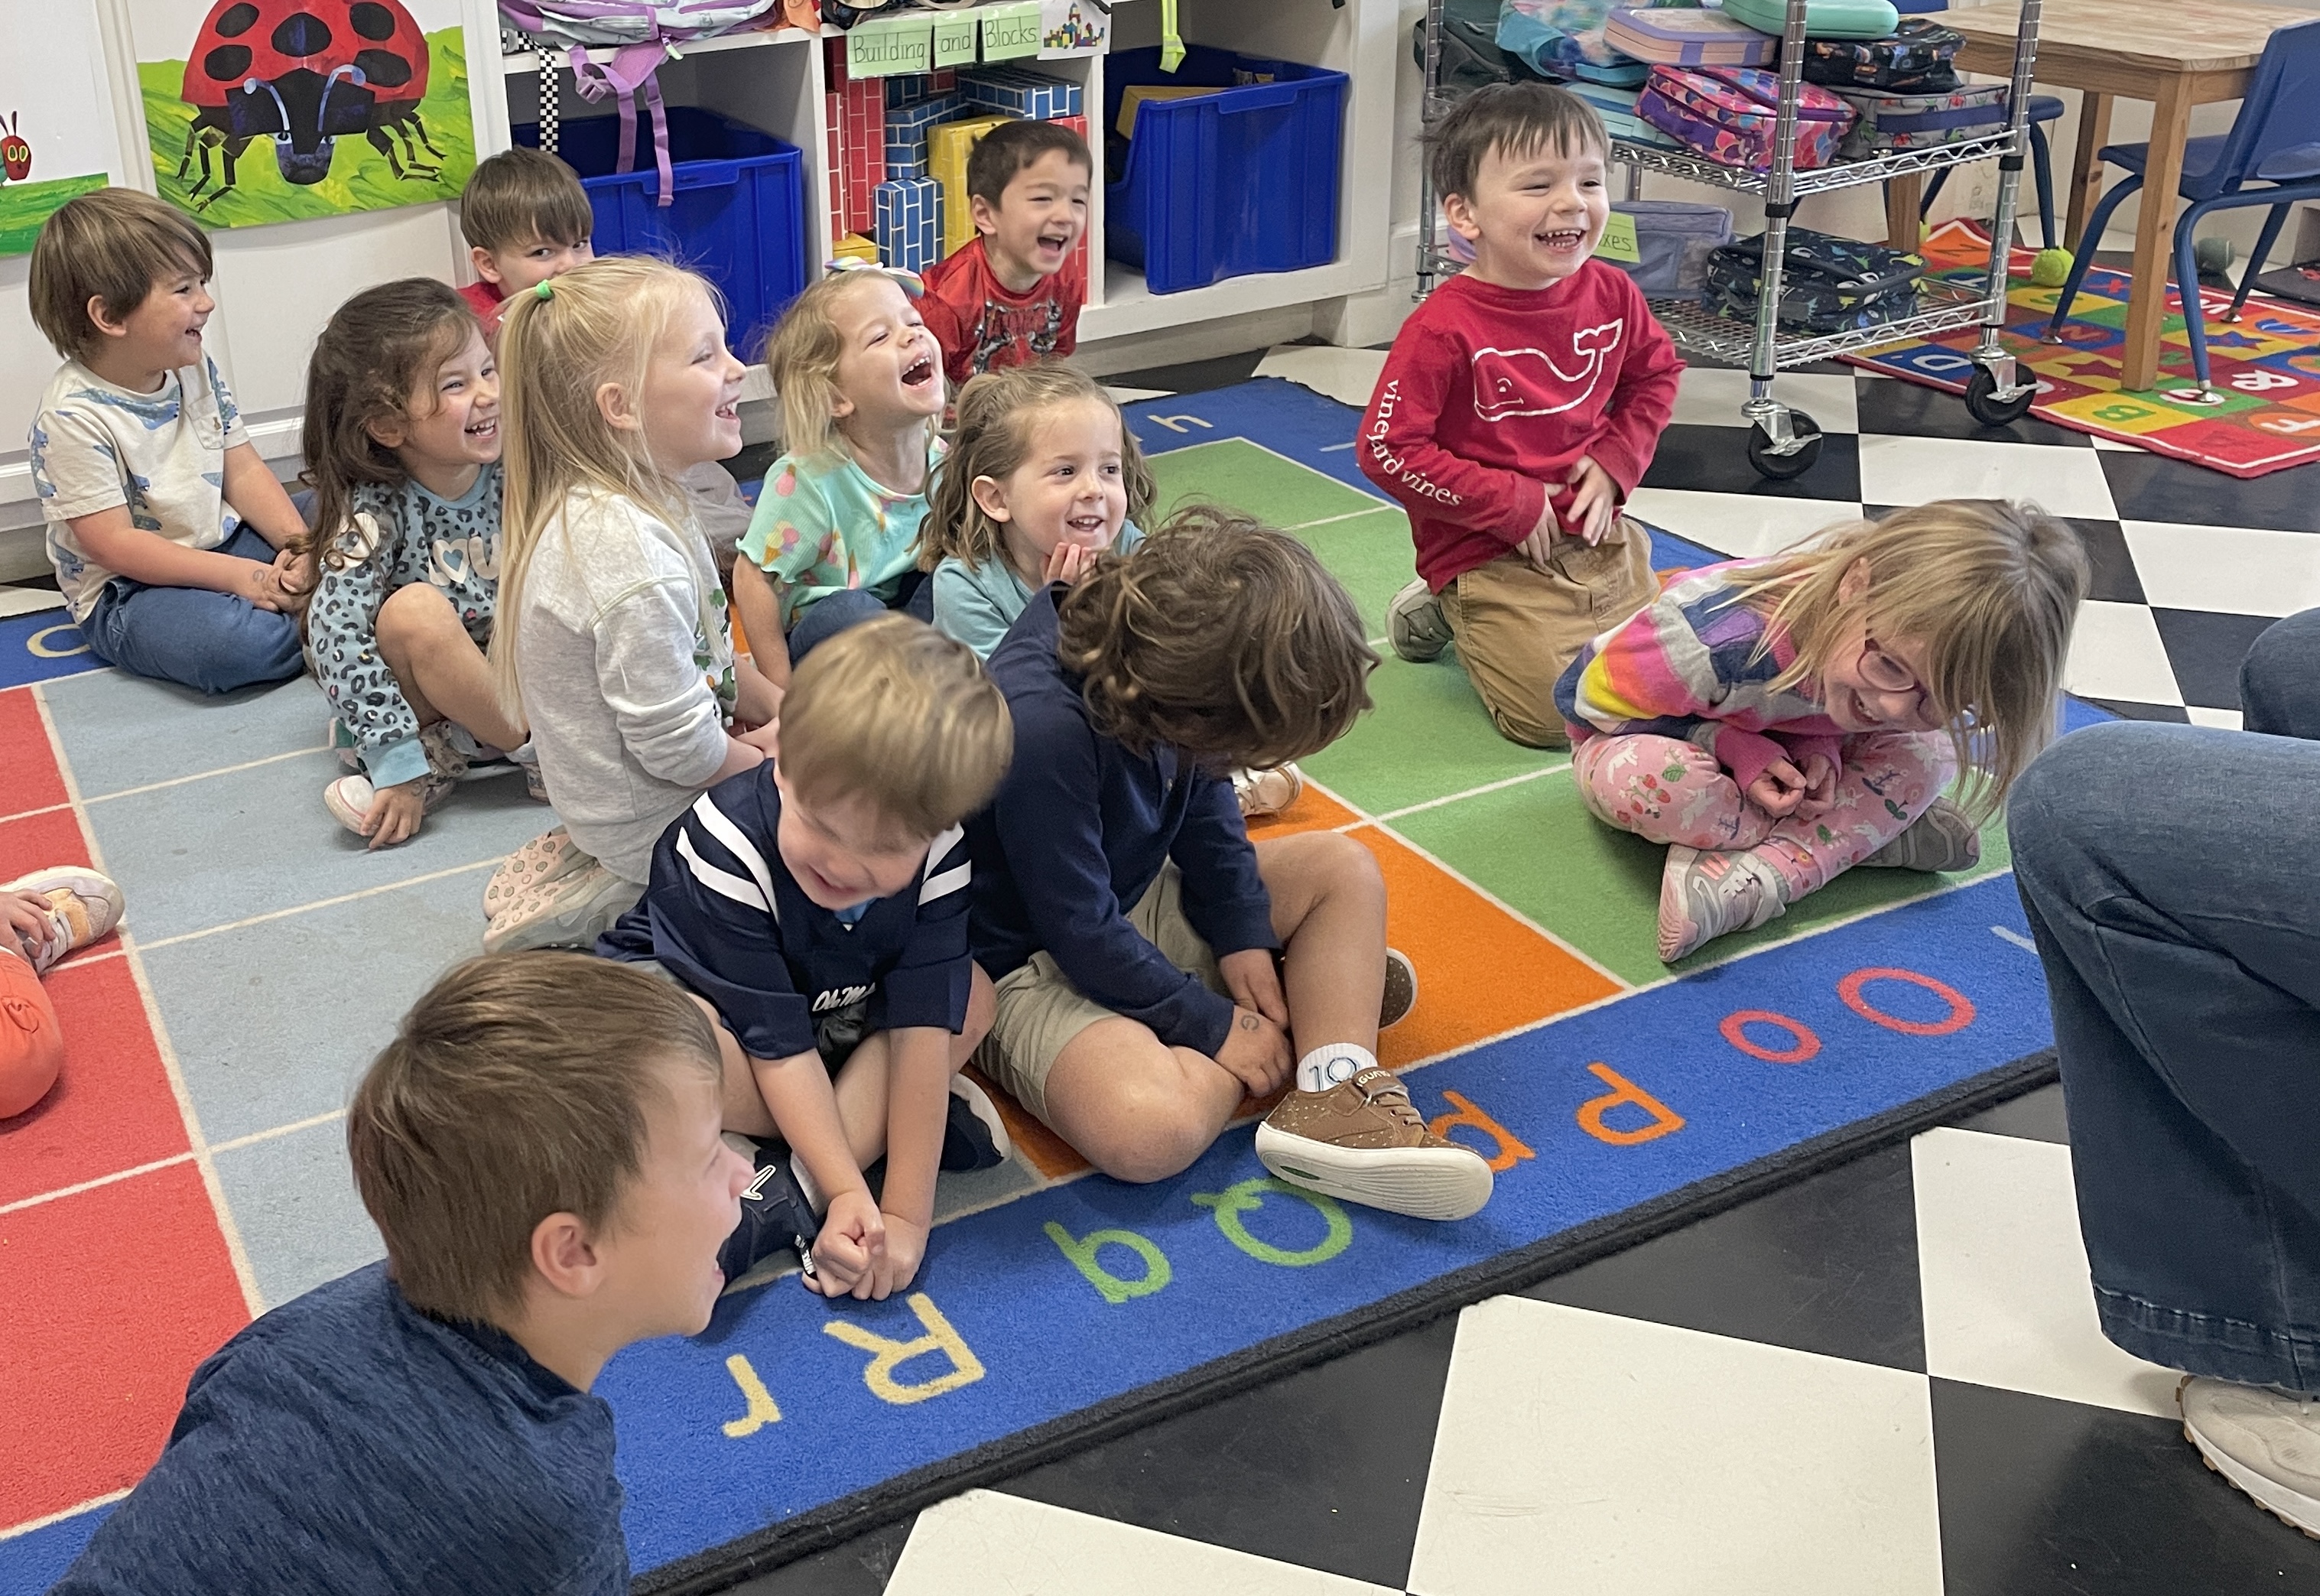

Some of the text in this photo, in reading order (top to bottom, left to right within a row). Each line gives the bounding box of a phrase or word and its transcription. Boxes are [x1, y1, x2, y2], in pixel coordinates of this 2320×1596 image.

[853, 16, 1037, 69] Building and Blocks
[1599, 234, 1632, 252] xes
[1366, 379, 1463, 506] vineyard vines
[1838, 967, 1977, 1036] O
[1576, 1061, 1686, 1146] P
[1190, 1178, 1353, 1266] Q
[823, 1292, 986, 1405] R
[722, 1354, 781, 1438] r
